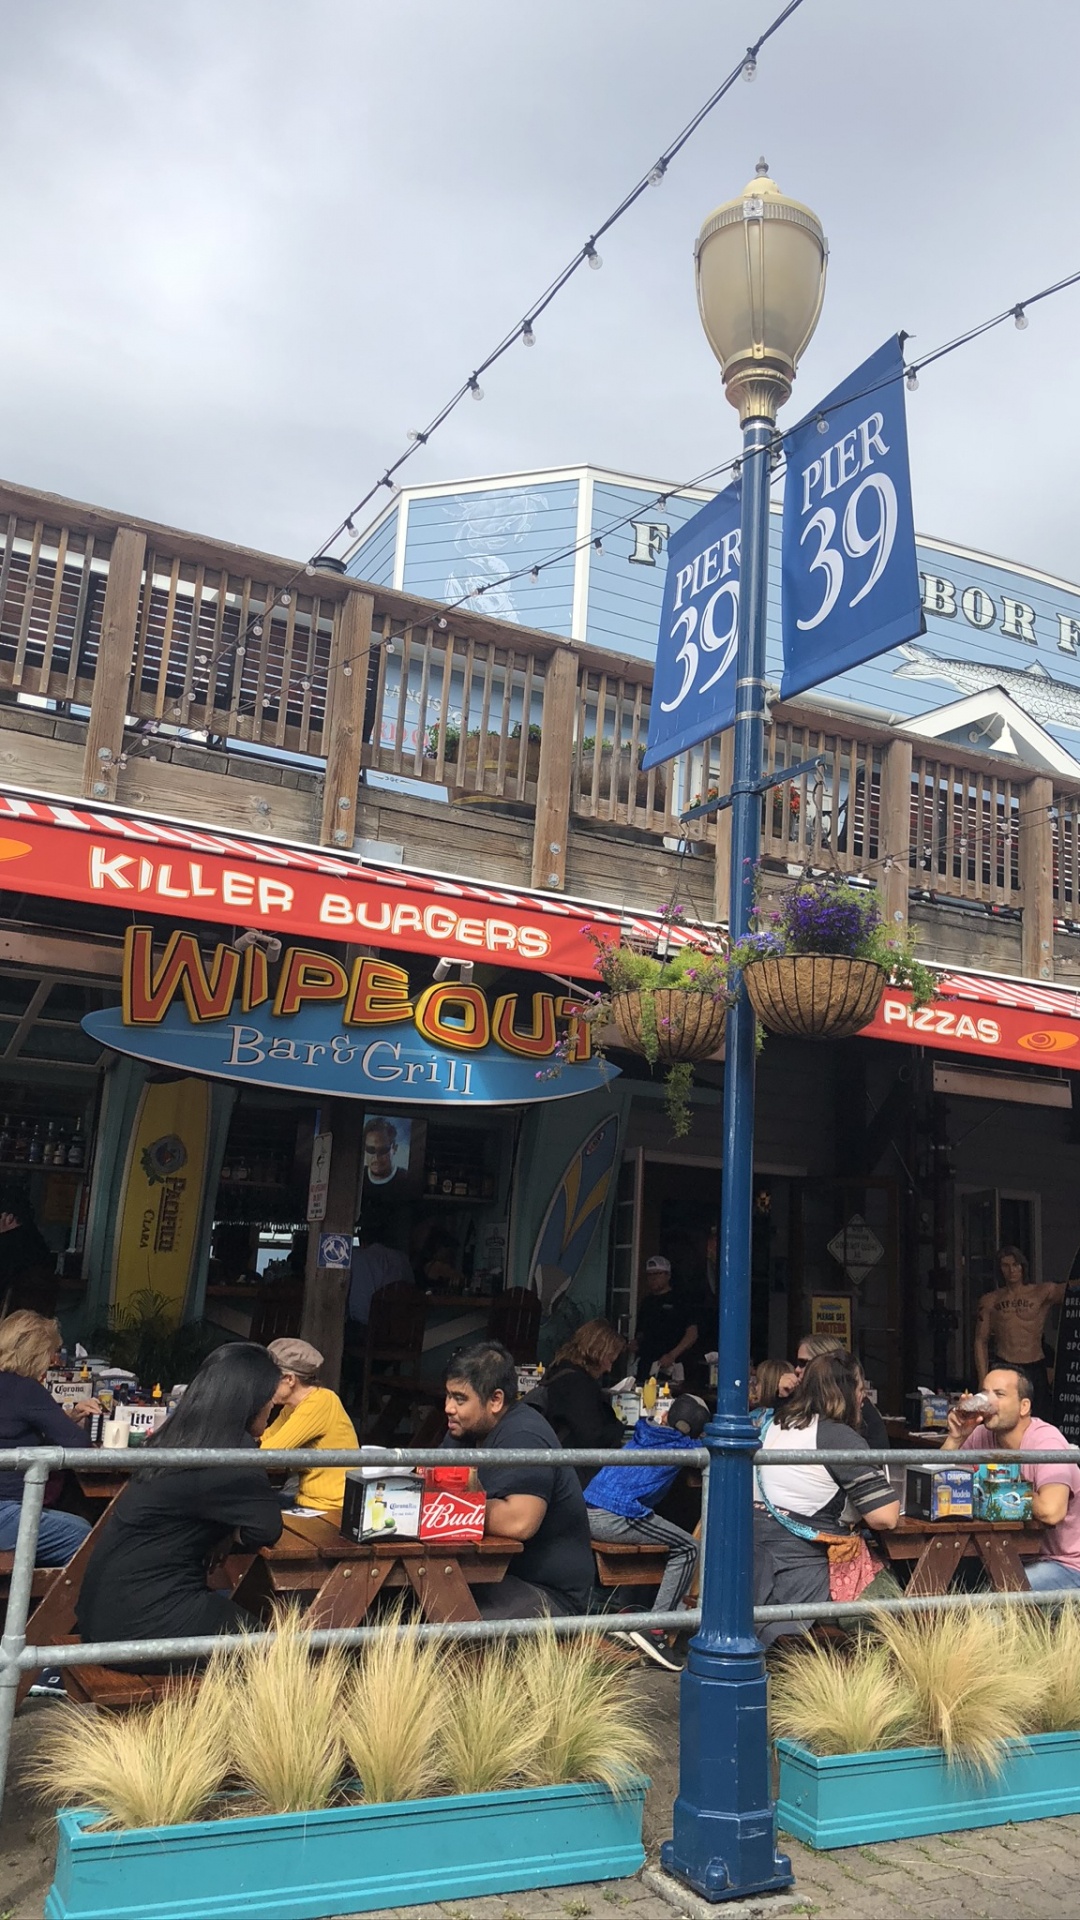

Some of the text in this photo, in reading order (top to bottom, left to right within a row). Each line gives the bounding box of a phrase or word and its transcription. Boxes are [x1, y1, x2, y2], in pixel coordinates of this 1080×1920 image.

[801, 411, 891, 516] PIER
[672, 527, 742, 613] PIER
[796, 472, 899, 631] 39
[659, 580, 741, 713] 39
[88, 846, 553, 960] KILLER BURGERS
[882, 999, 1002, 1045] PIZZAS
[222, 1024, 326, 1067] Bar
[361, 1040, 475, 1096] Grill
[139, 1208, 156, 1248] CLARA
[1065, 1297, 1080, 1306] BRE
[54, 1384, 84, 1395] Corona
[130, 1412, 154, 1427] Lite
[952, 1489, 971, 1498] Modelo
